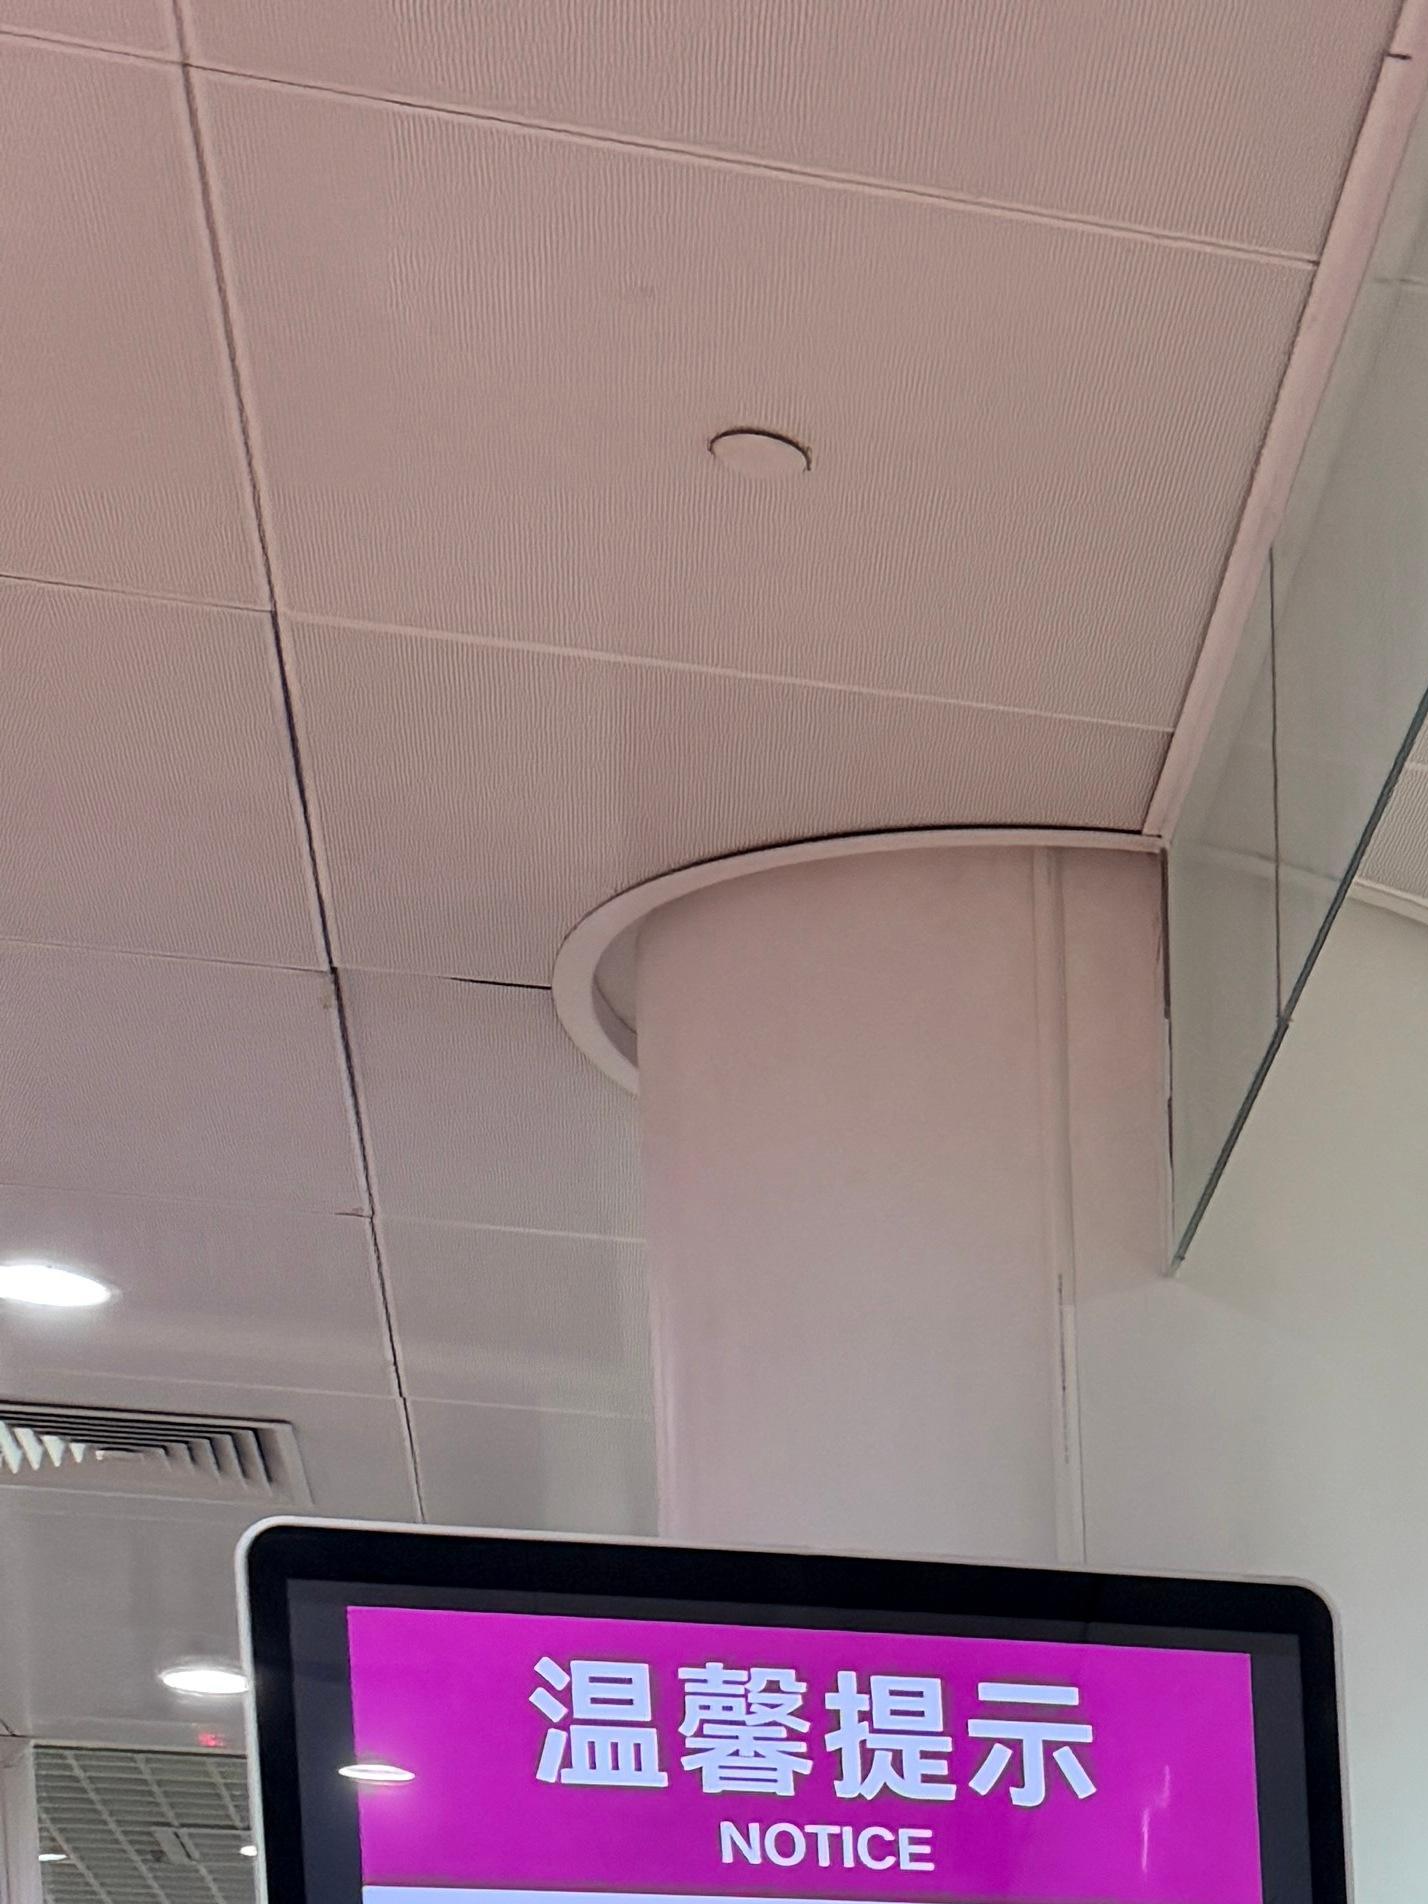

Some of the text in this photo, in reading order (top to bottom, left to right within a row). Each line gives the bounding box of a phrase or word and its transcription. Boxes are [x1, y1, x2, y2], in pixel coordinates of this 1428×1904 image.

[526, 1655, 1098, 1809] 温馨提示
[719, 1821, 935, 1871] NOTICE
